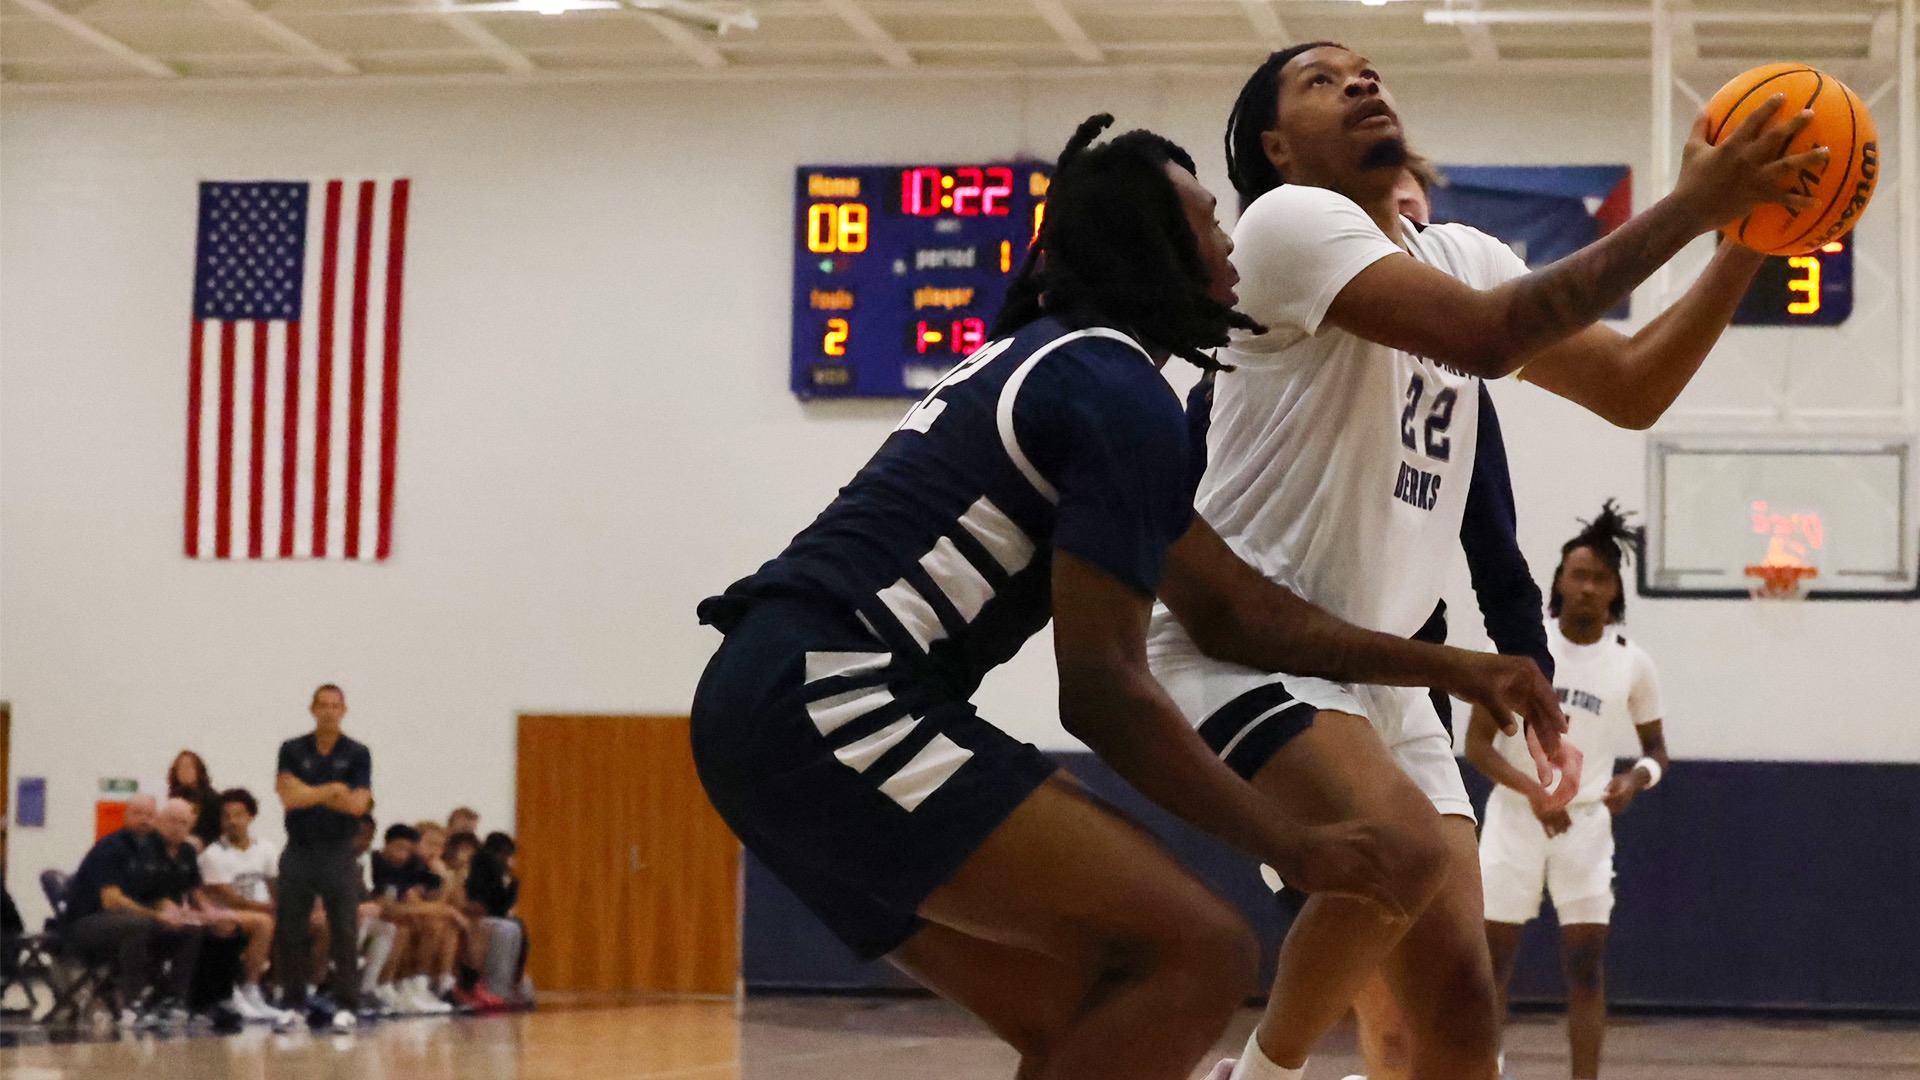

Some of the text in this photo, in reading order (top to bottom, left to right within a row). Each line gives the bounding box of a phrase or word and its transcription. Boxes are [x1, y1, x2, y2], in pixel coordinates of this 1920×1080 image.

[902, 167, 1013, 216] 10:22
[807, 203, 868, 253] 08
[823, 318, 849, 356] 2
[1401, 373, 1457, 463] 22
